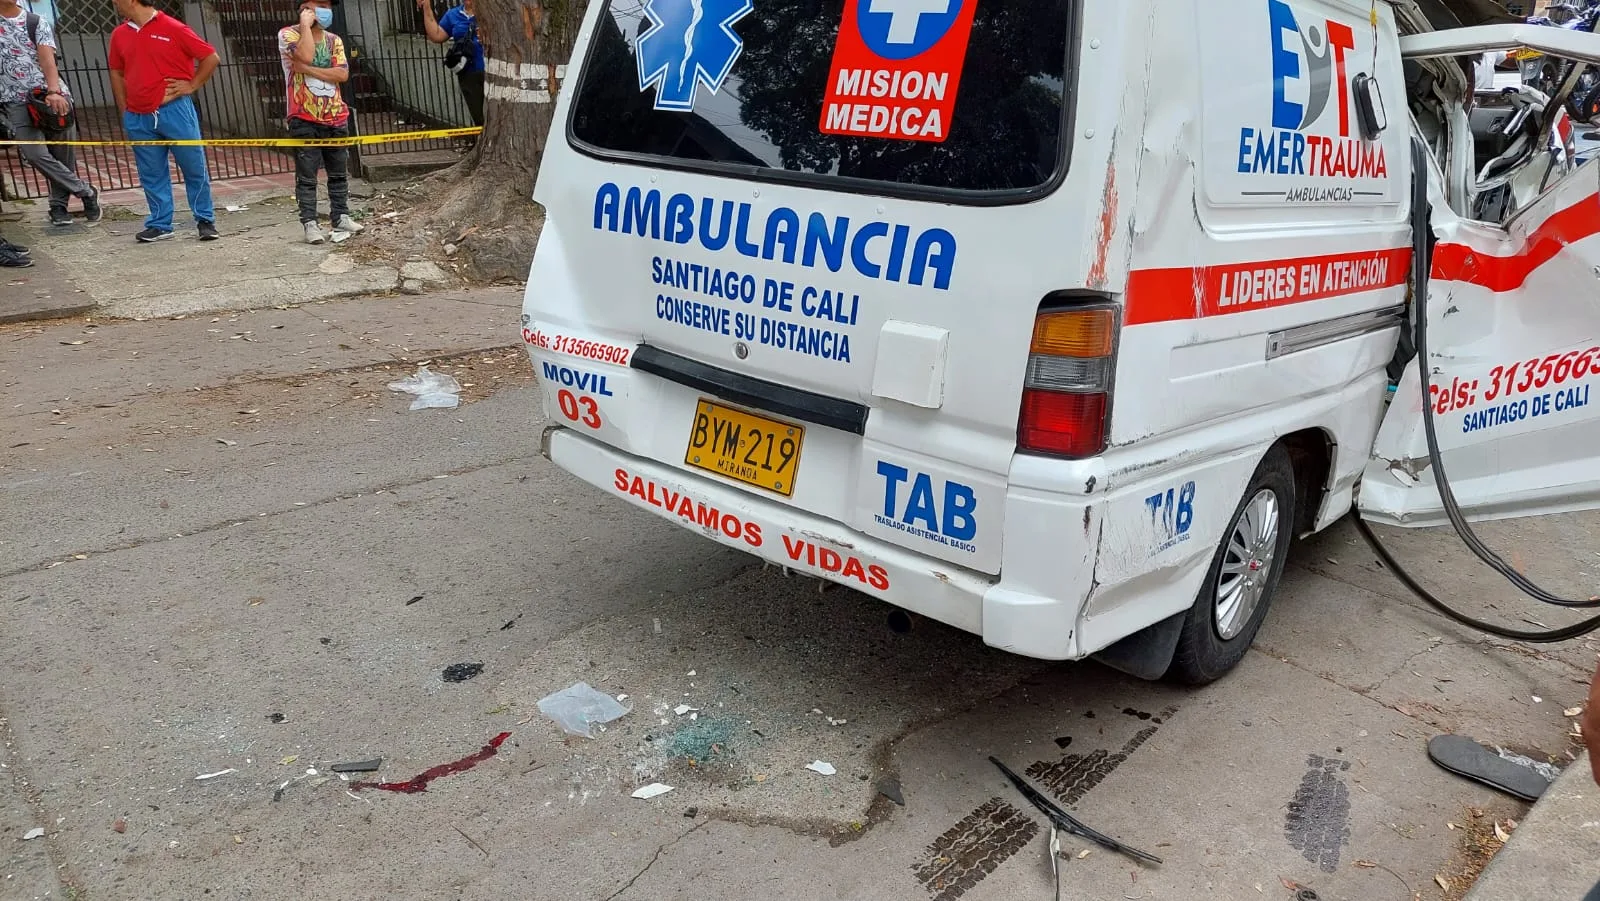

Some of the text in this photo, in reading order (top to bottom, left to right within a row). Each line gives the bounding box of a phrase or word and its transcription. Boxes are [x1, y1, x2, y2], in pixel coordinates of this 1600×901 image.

[835, 69, 949, 100] MISION
[825, 103, 942, 138] MEDICA
[1237, 127, 1388, 179] EMERTRAUMA
[1285, 186, 1353, 202] AMBULANCIAS
[593, 182, 957, 290] AMBULANCIA
[651, 256, 860, 326] SANTIAGO DE CALI
[1219, 252, 1389, 308] LIDERES EN ATENCIÓN
[523, 328, 629, 365] Cels: 3135665902
[656, 294, 851, 363] CONSERVE SU DISTANCIA
[543, 361, 613, 397] MOVIL
[557, 388, 602, 429] 03
[1462, 384, 1589, 433] SANTIAGO DE CALI
[717, 458, 757, 481] MIRANDA
[877, 460, 977, 541] TAB
[614, 468, 890, 591] SALVAMOS VIDAS
[874, 514, 976, 553] TRASLADO ASISTENCIAL BASICO
